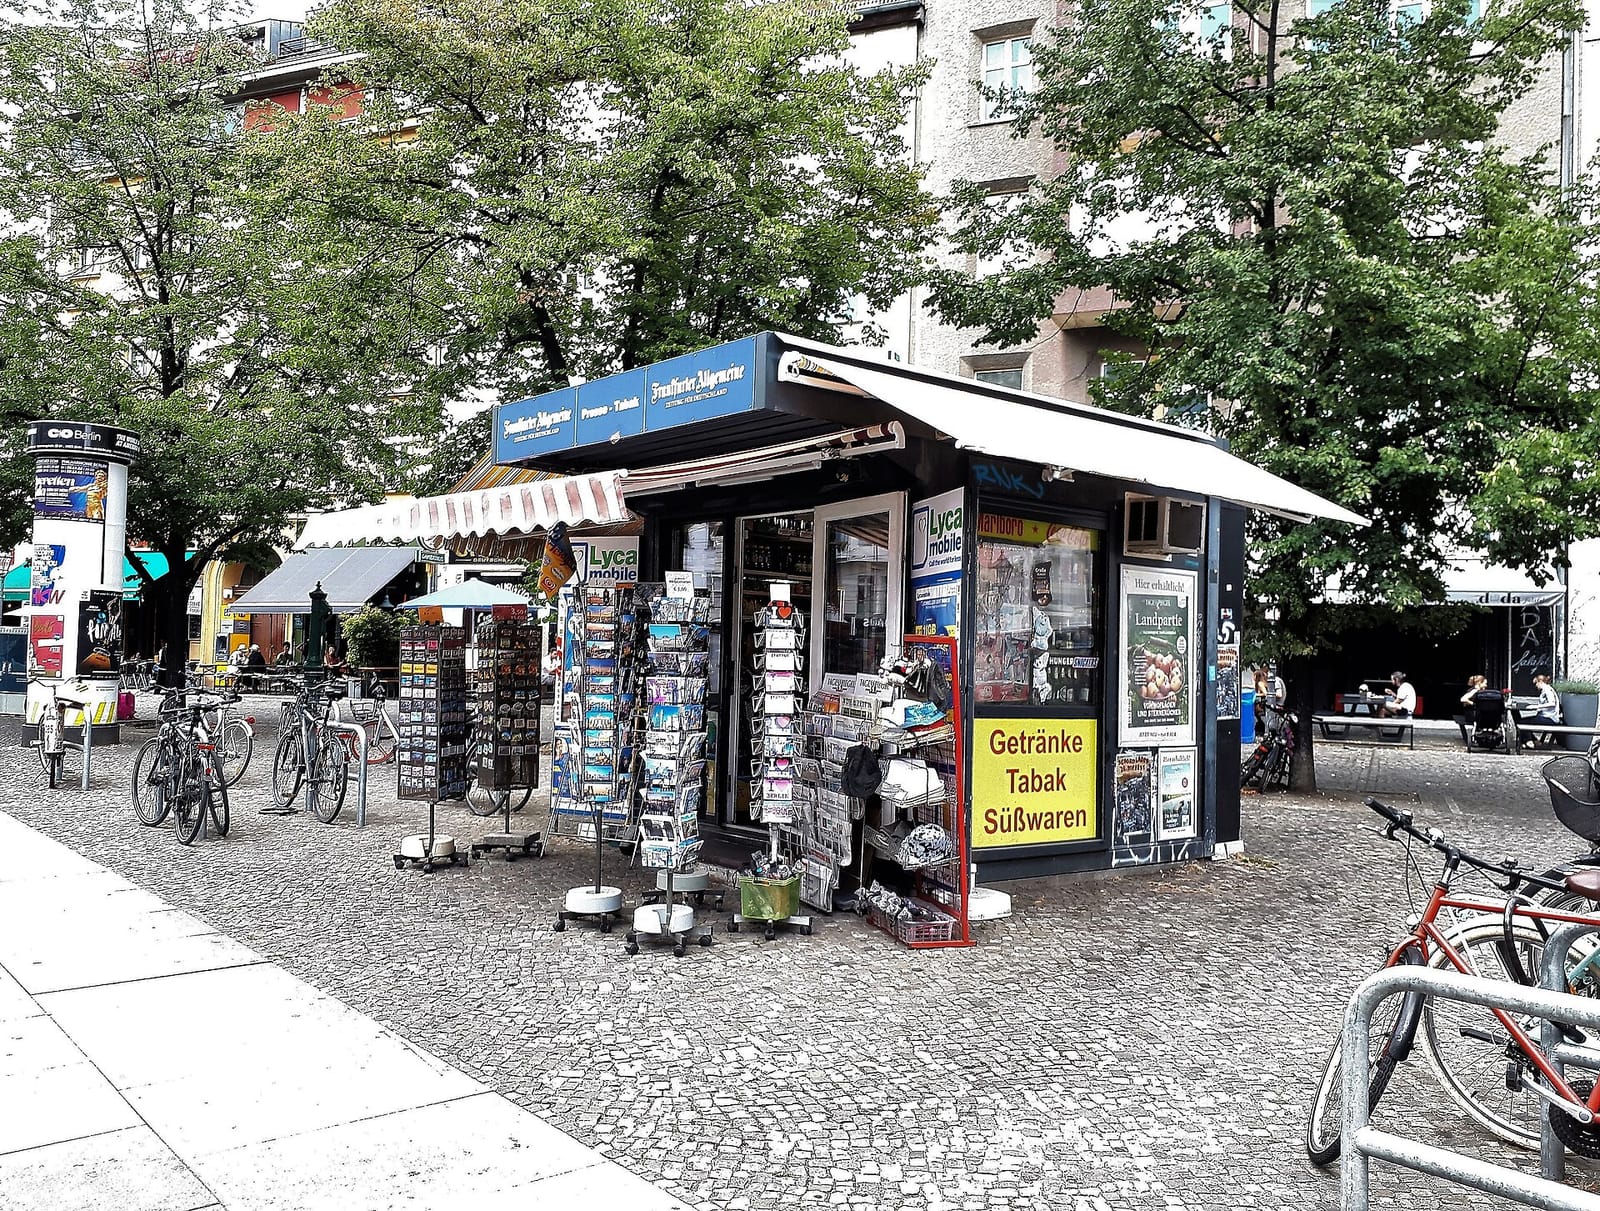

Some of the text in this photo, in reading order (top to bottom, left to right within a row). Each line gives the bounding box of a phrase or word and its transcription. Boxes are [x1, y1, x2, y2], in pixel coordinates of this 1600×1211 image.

[696, 362, 745, 393] Allgemeine
[74, 430, 102, 442] Berlin
[929, 507, 962, 540] Lyca
[590, 545, 638, 570] Lyca
[929, 536, 961, 557] mobile
[590, 566, 636, 581] mobile
[1135, 578, 1185, 593] Hier erhältlich!
[1135, 611, 1183, 630] Landpartie
[990, 729, 1083, 755] Getränke
[1006, 767, 1067, 794] Tabak
[984, 807, 1087, 835] Süßwaren
